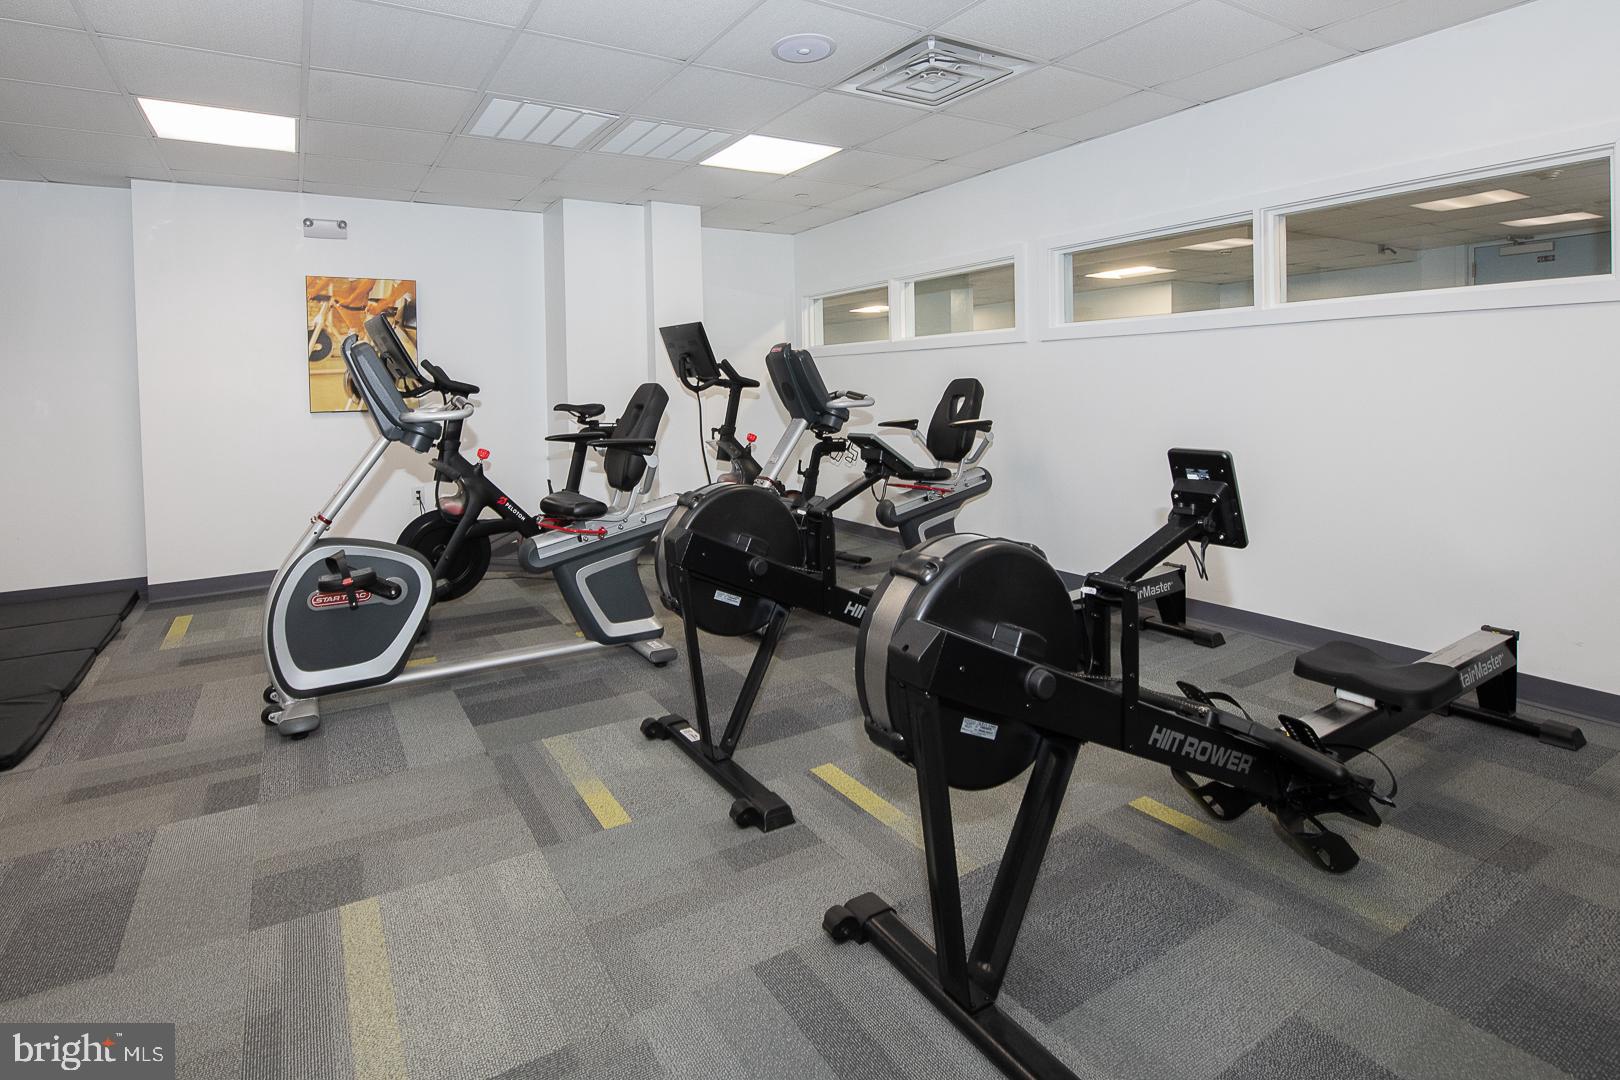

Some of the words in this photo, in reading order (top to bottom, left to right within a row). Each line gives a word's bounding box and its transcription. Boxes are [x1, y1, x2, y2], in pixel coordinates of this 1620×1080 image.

[504, 502, 526, 521] PELOTON
[316, 595, 341, 604] STAR
[341, 591, 367, 601] TAC
[1137, 581, 1172, 600] irMaster
[843, 600, 867, 619] HII
[1460, 653, 1503, 688] tairMaster
[1147, 724, 1185, 753] HIIT
[1181, 735, 1253, 774] ROWER
